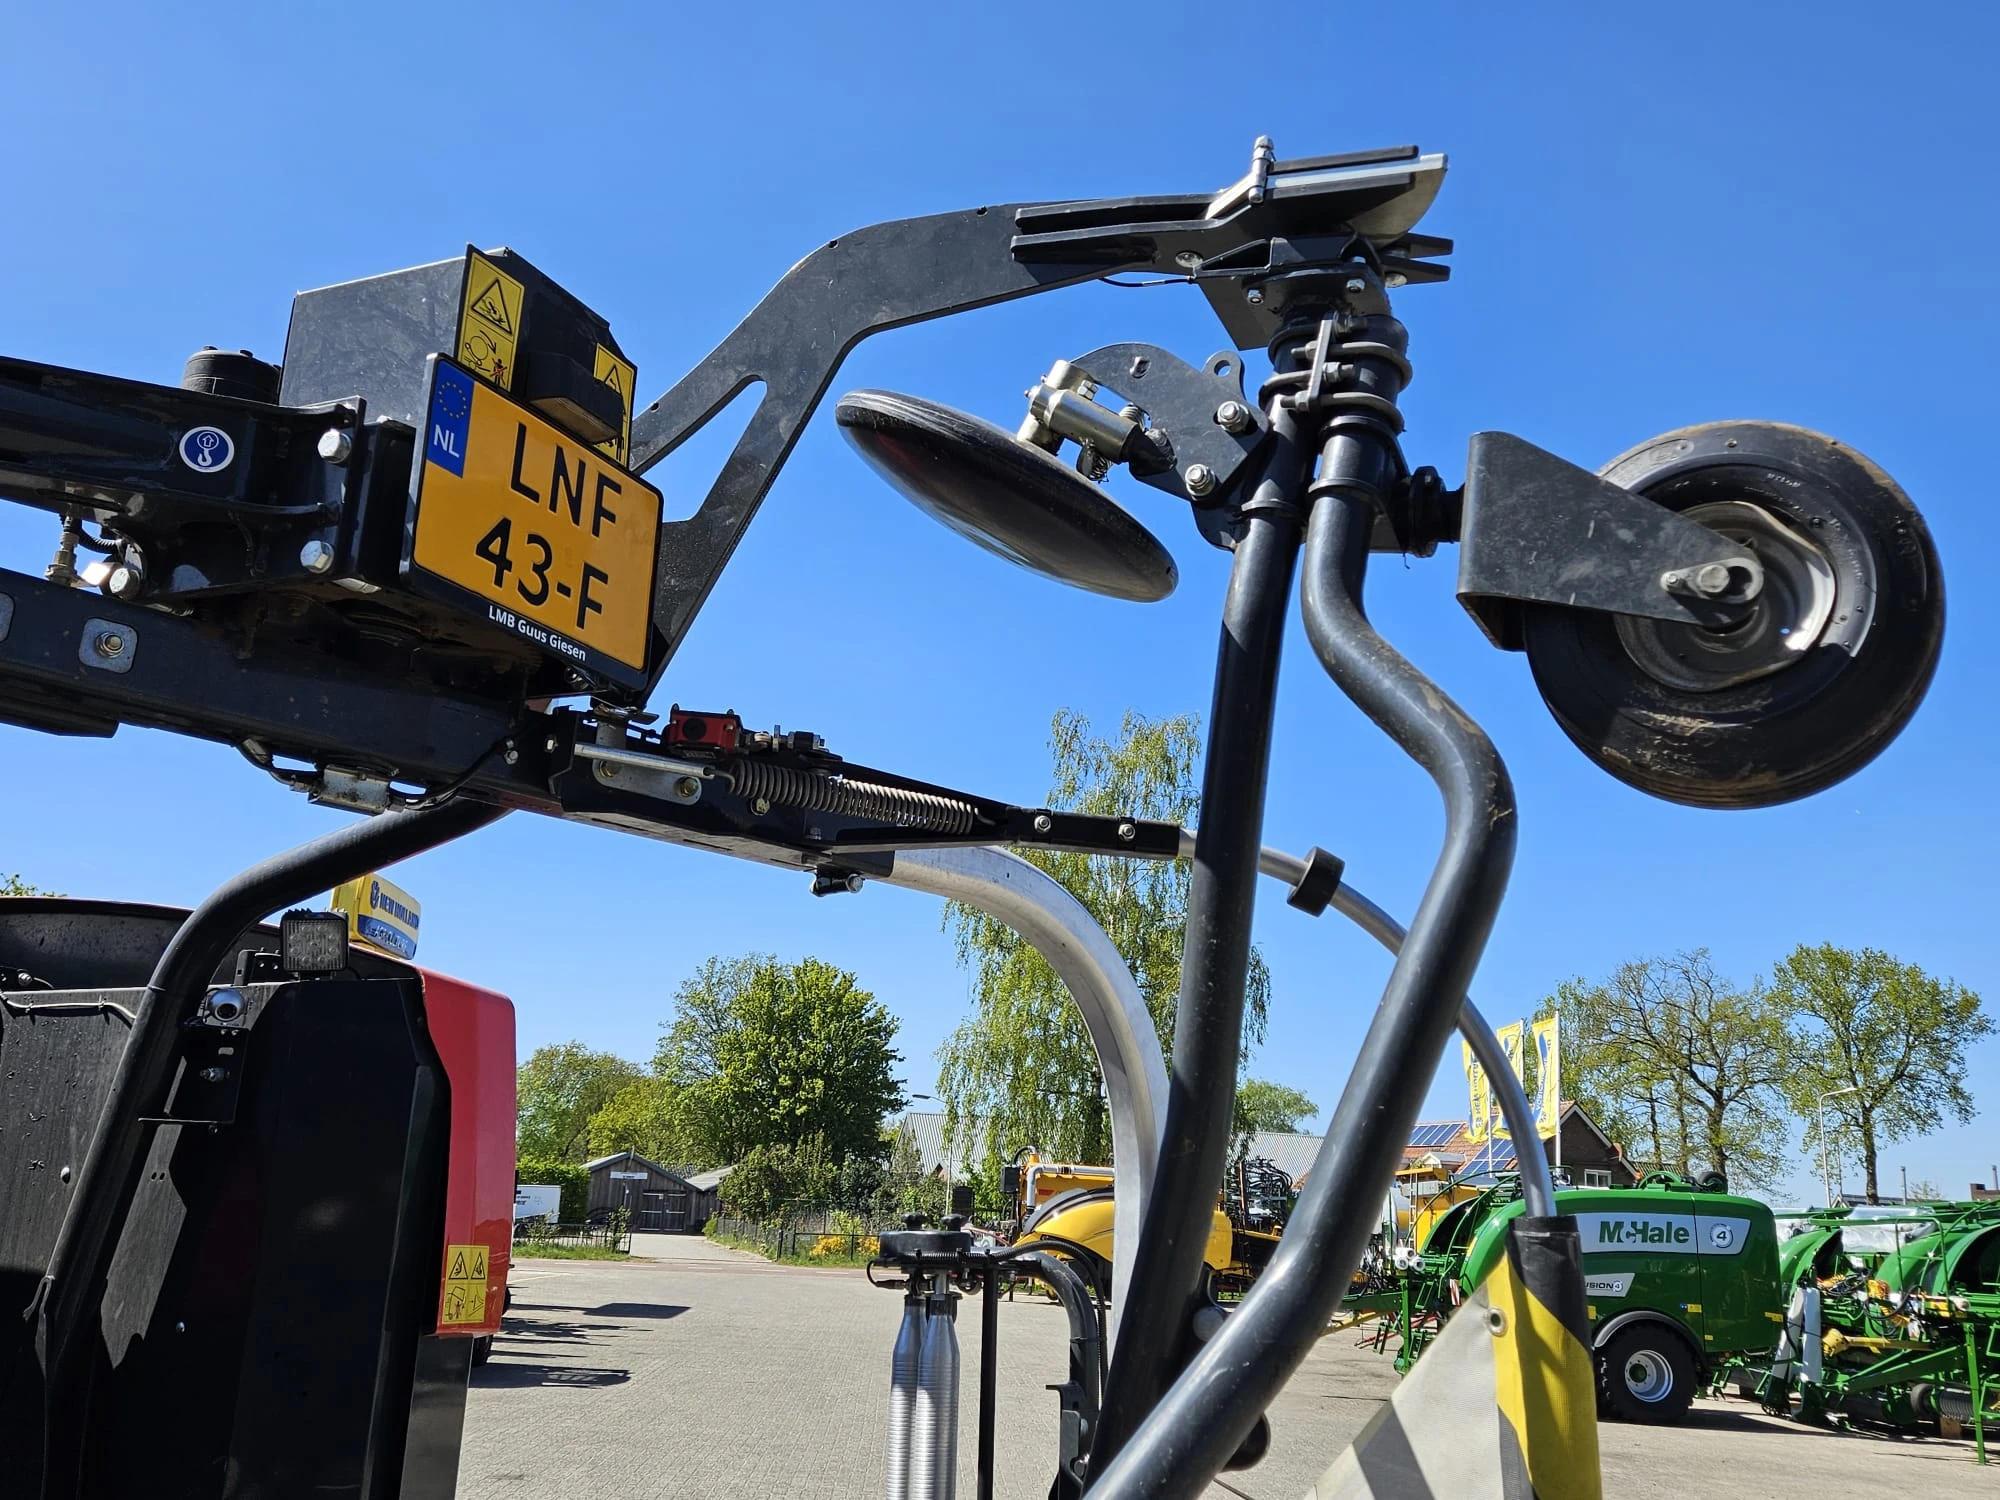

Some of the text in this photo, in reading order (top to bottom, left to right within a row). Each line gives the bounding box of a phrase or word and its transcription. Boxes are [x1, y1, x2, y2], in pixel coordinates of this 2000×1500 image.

[433, 423, 460, 458] NL
[511, 422, 622, 538] LNF
[475, 517, 609, 630] 43-F
[488, 605, 586, 661] LMB Guus Giesen
[380, 892, 420, 930] NEW HOLLAND
[1599, 1221, 1727, 1243] McHale 4
